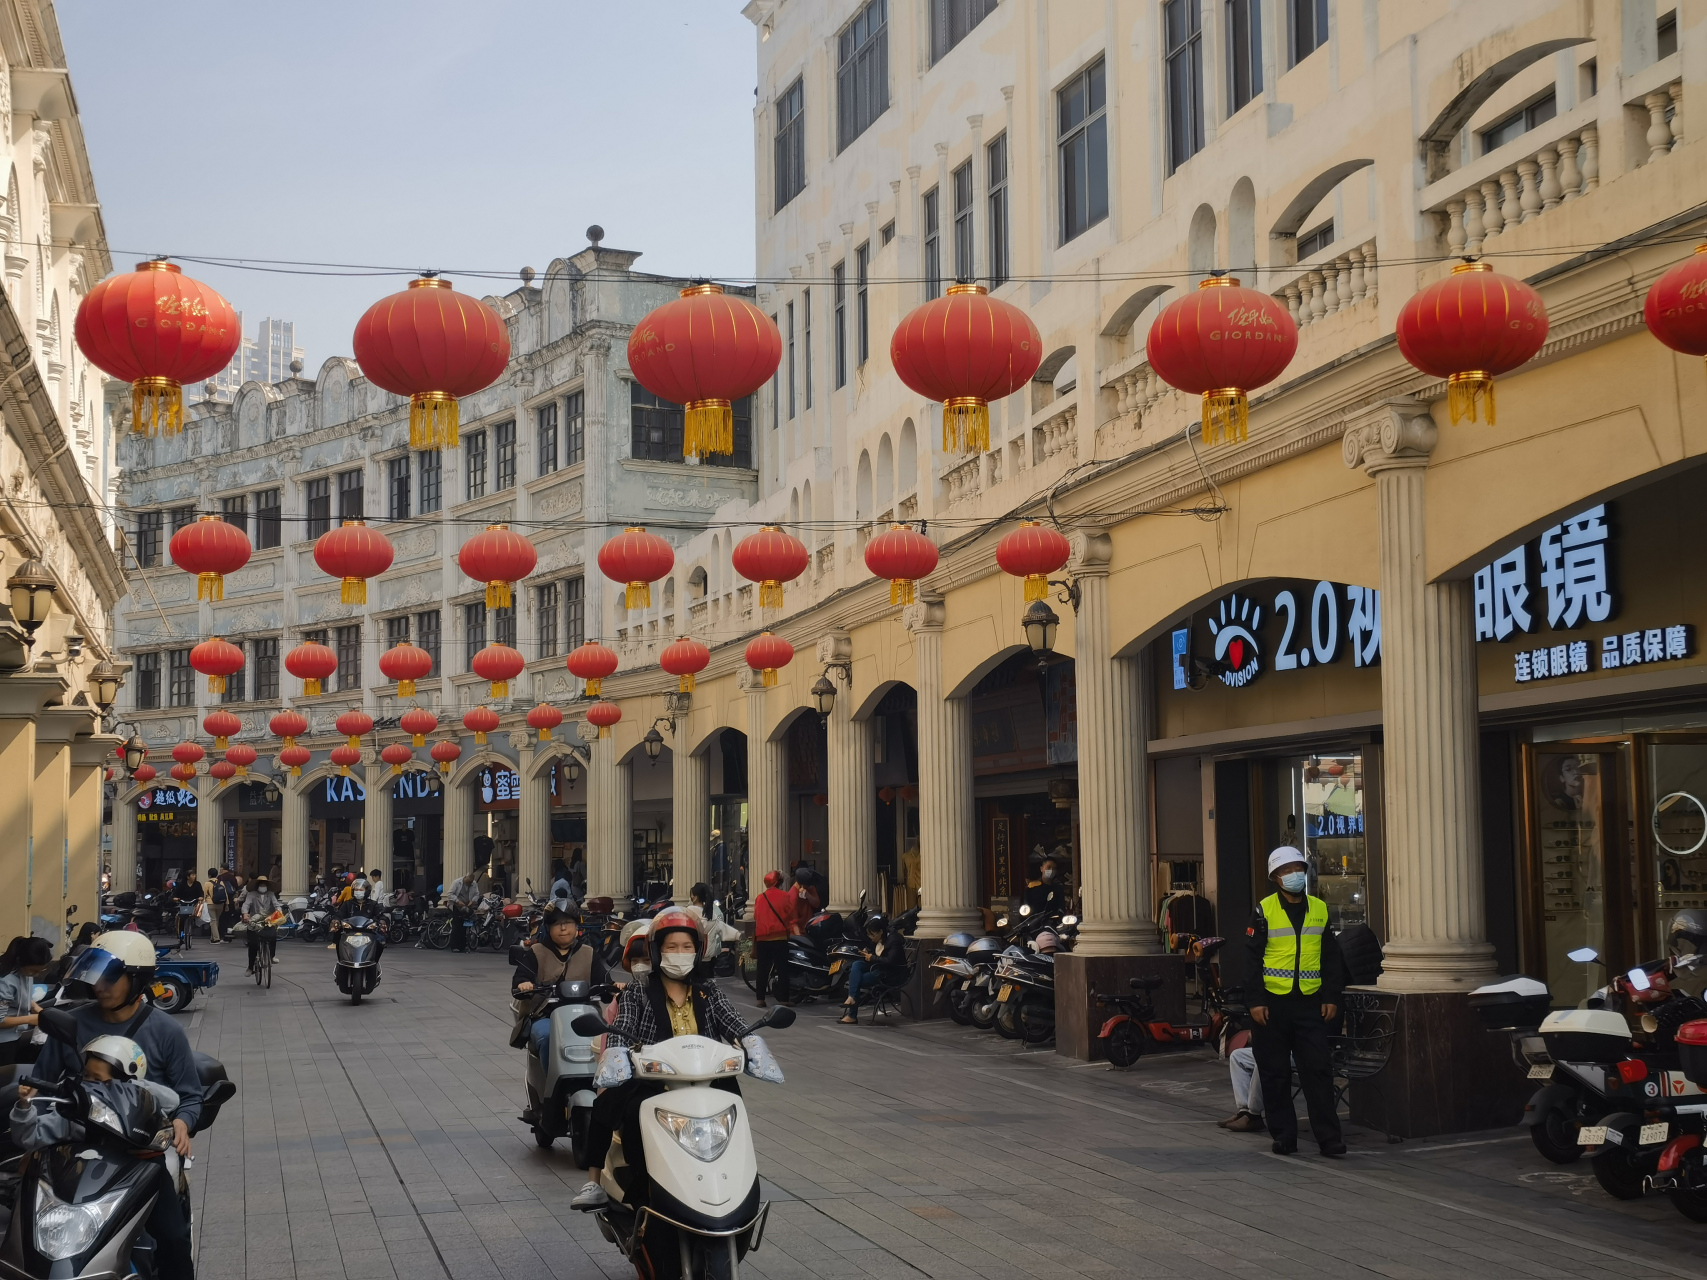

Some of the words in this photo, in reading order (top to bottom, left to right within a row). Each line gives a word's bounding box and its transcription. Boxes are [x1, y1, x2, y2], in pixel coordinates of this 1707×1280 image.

[1210, 330, 1289, 343] GIORDAN
[1514, 641, 1588, 682] 连锁眼镜
[1601, 625, 1687, 669] 品质保障
[1647, 1083, 1656, 1095] 3
